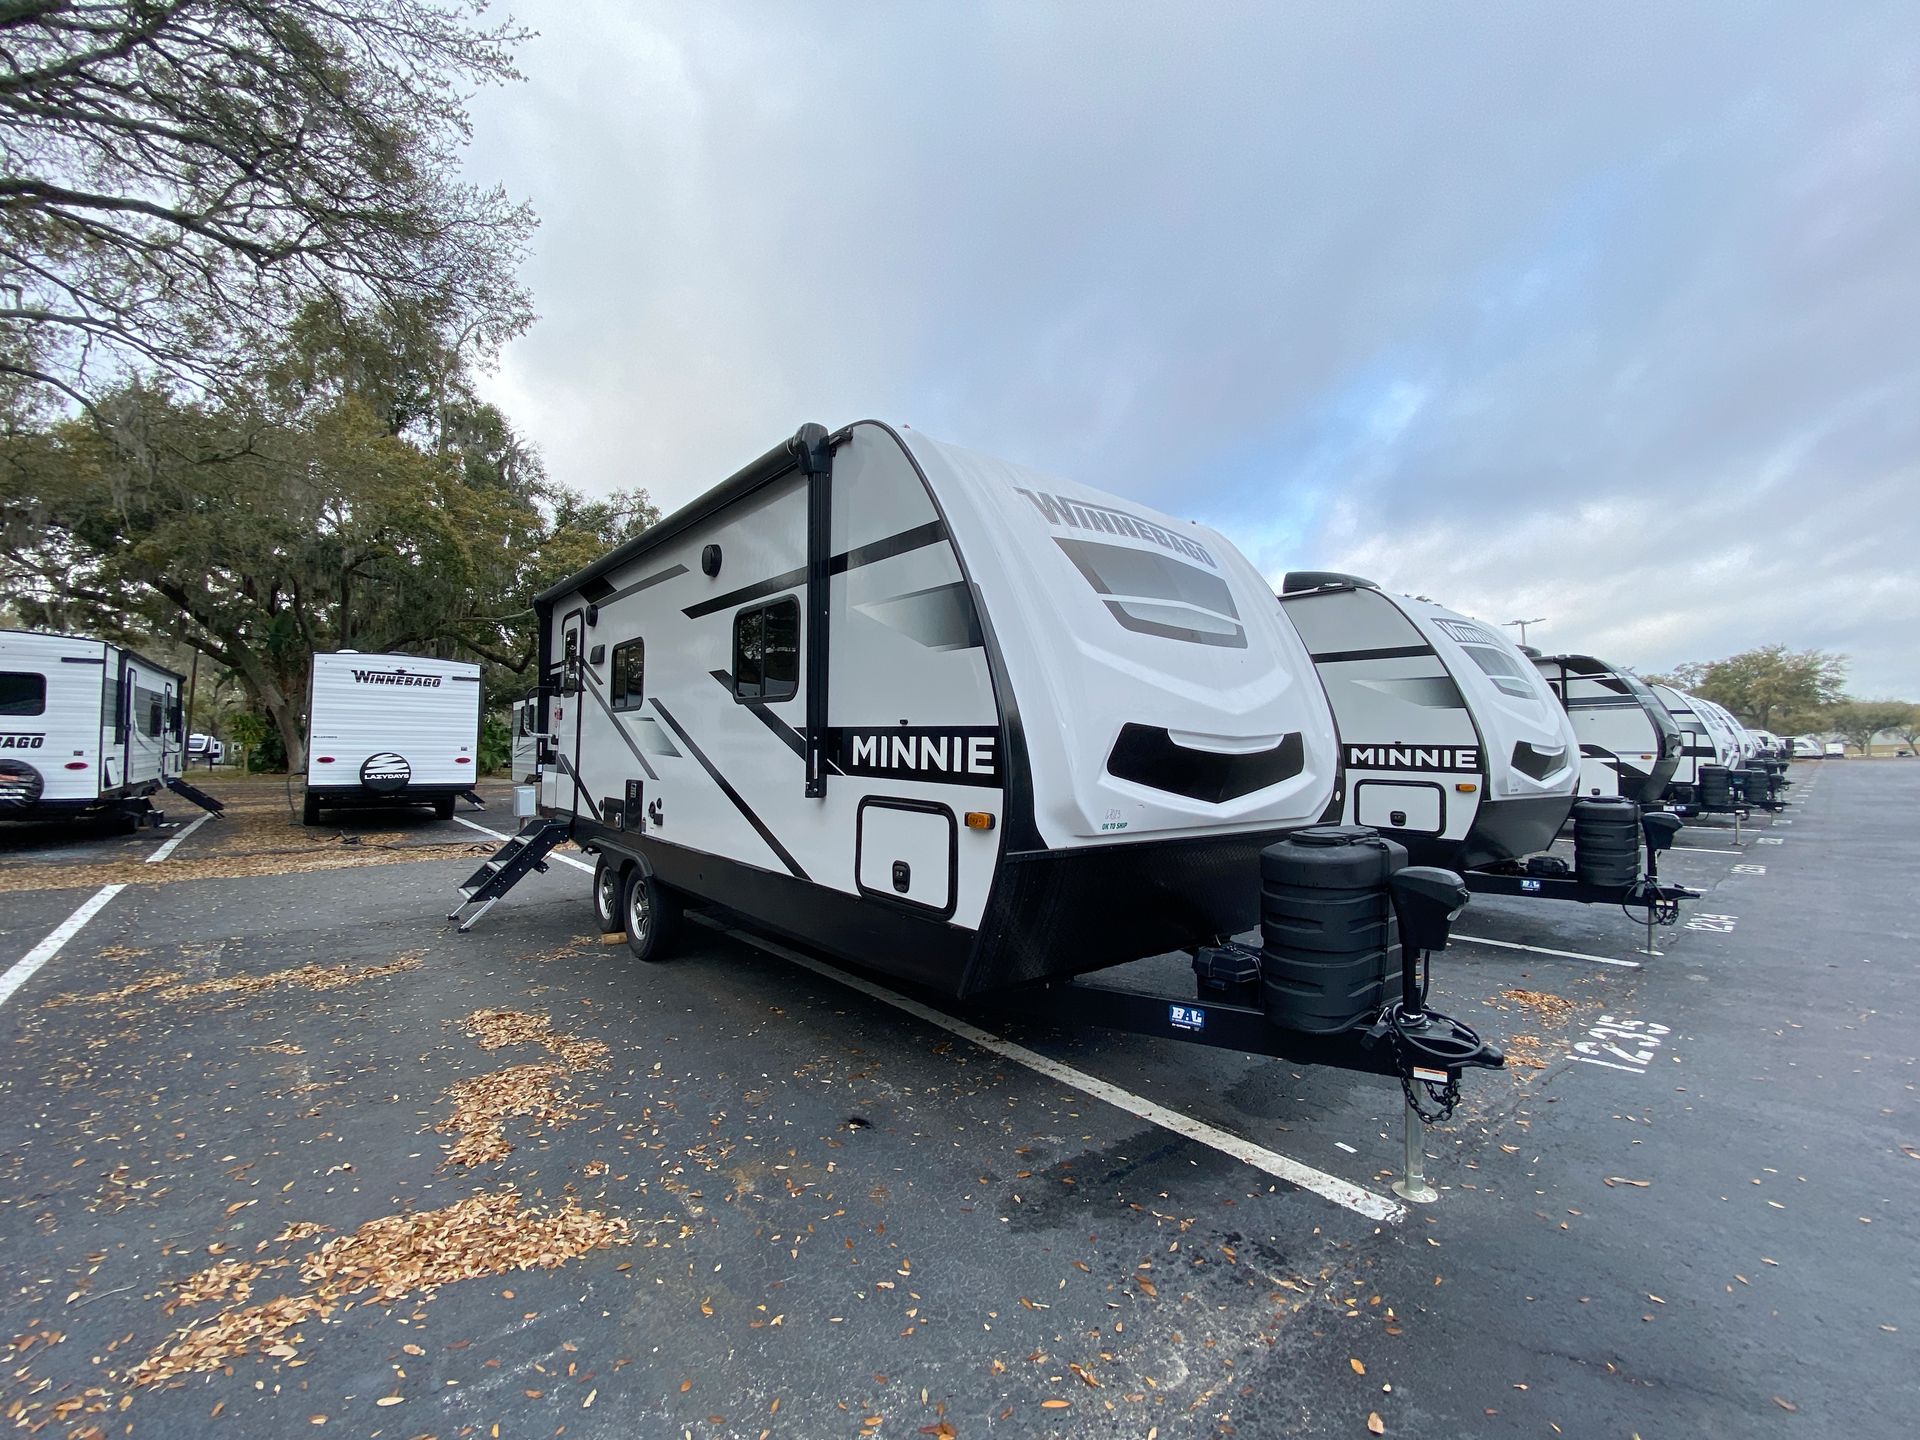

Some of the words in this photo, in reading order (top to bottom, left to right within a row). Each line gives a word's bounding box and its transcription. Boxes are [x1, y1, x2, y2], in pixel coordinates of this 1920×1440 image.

[1013, 487, 1218, 569] WINNEBAGO
[351, 670, 442, 687] WINNEBAGO
[852, 735, 995, 774] MINNIE
[1350, 747, 1477, 769] MINNIE
[1683, 912, 1739, 933] 1234
[1565, 1015, 1671, 1073] 1235
